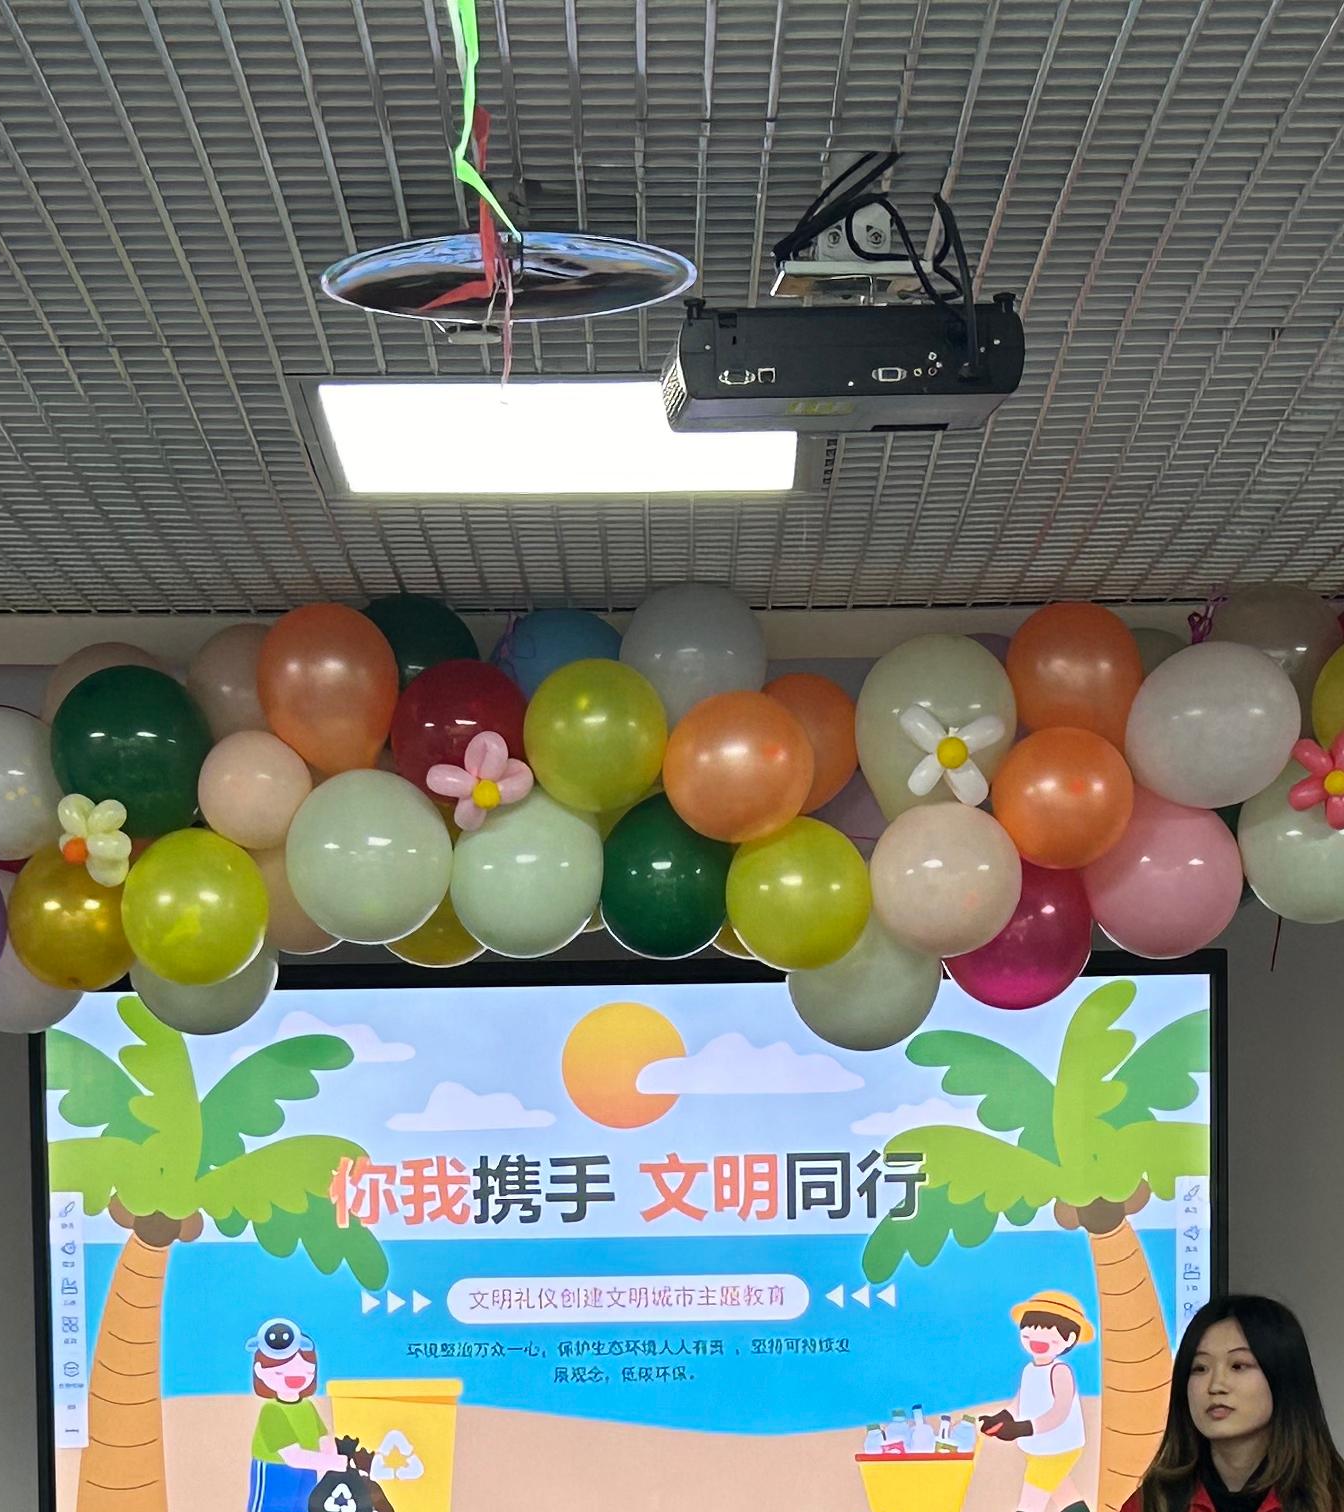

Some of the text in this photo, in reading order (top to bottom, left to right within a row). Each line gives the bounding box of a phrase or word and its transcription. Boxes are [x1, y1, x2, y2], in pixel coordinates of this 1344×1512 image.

[329, 1149, 927, 1226] 你我携手 文明同行
[468, 1284, 786, 1311] 文明礼仪创建文明城市主题教育
